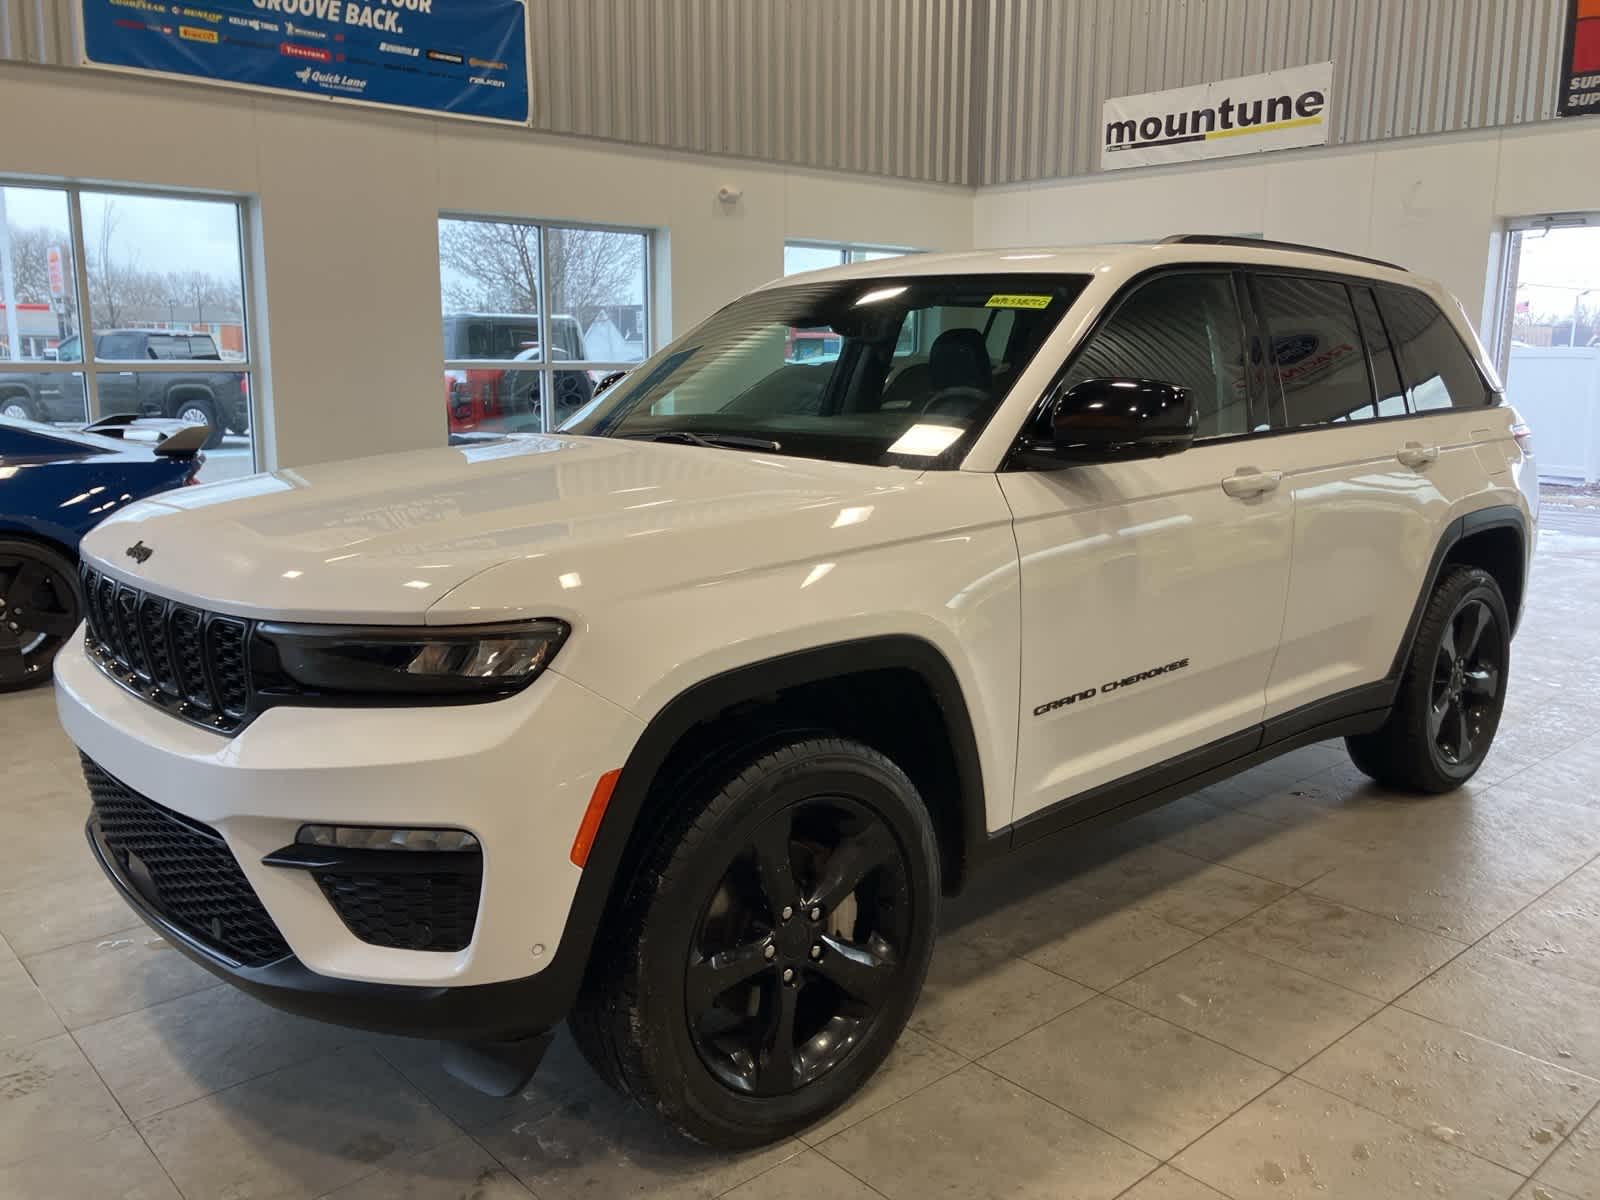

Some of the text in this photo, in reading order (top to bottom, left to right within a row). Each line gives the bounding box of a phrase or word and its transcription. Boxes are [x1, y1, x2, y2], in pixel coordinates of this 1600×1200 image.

[345, 2, 403, 33] BACK.
[311, 71, 341, 86] Quick
[341, 75, 367, 88] Lane
[1105, 90, 1325, 145] mountune
[1033, 657, 1190, 716] GRAND CHEROKEE
